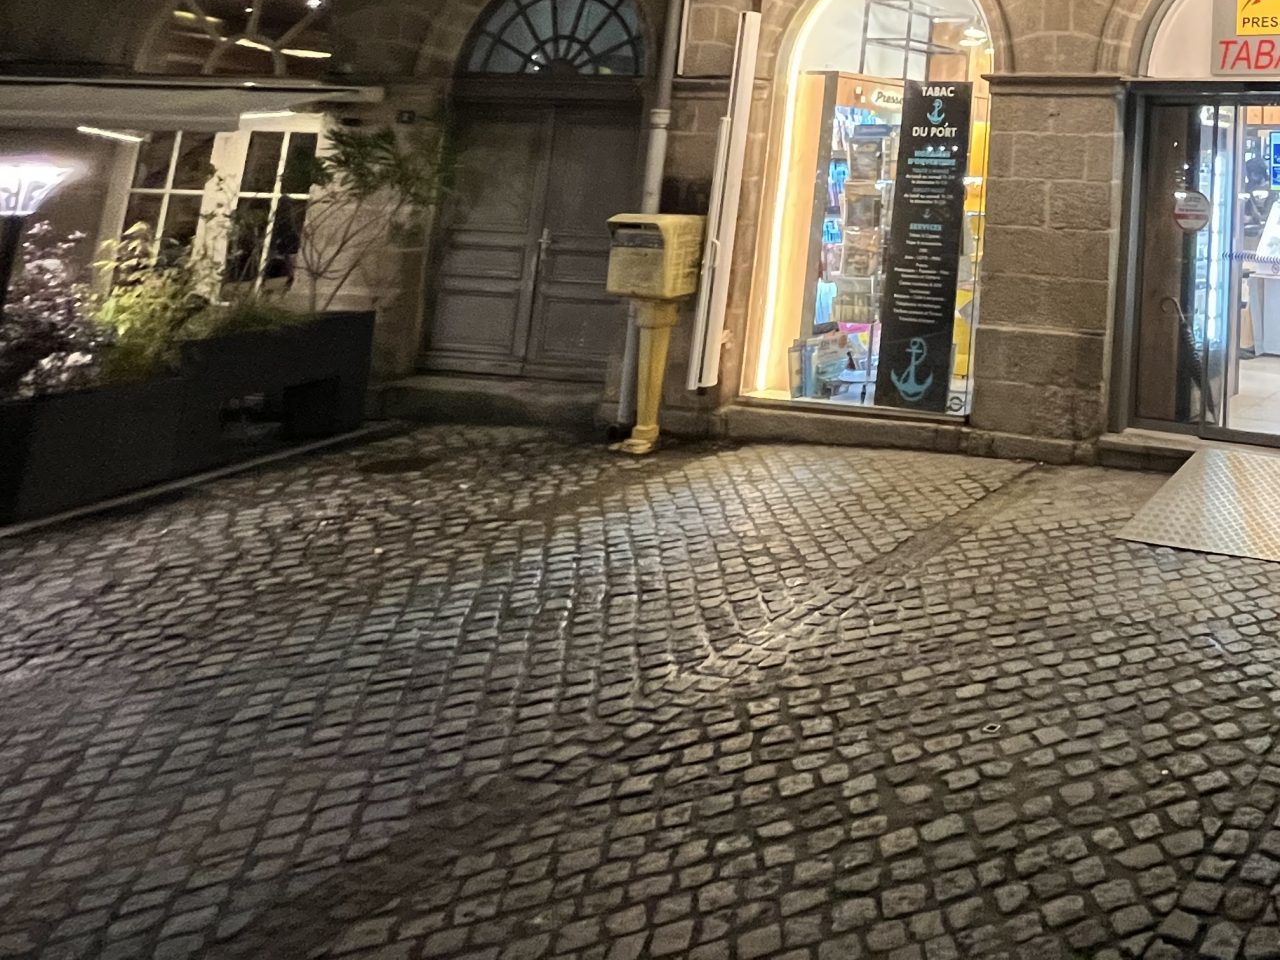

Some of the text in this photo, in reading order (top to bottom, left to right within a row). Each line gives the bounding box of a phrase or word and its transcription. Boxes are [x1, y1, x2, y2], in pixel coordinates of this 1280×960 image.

[921, 86, 955, 97] TABAC
[912, 126, 957, 138] DU PORT
